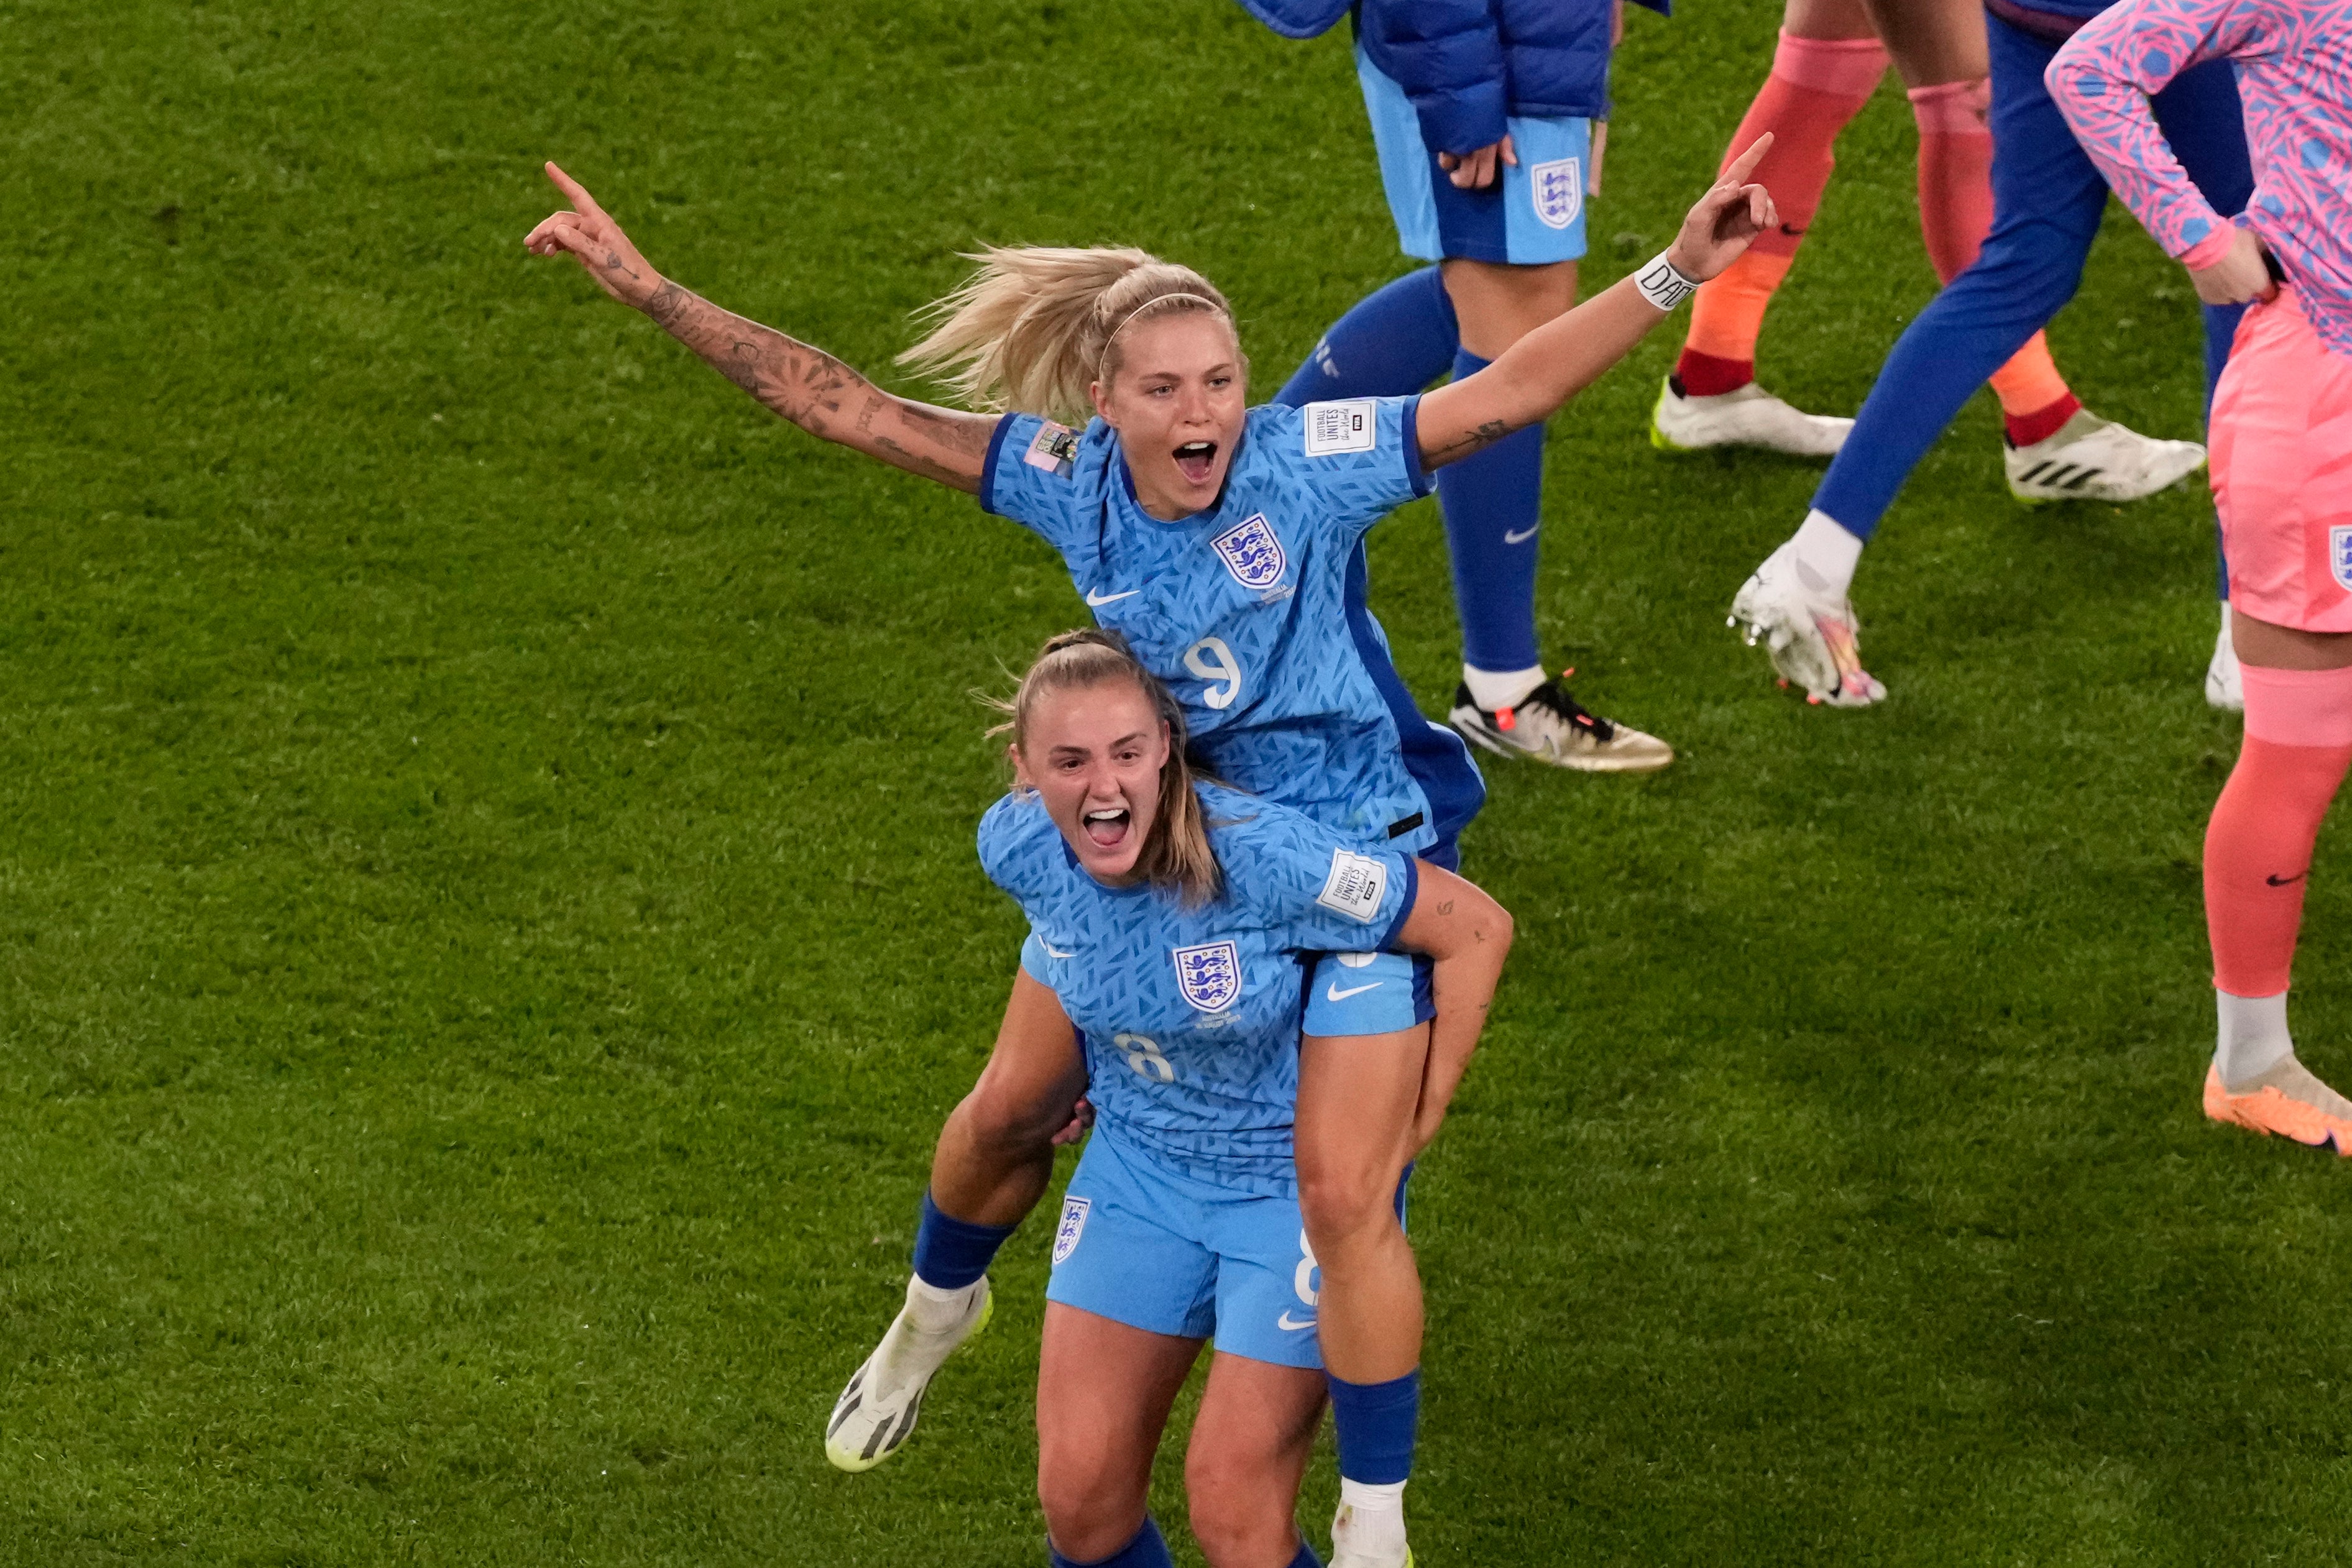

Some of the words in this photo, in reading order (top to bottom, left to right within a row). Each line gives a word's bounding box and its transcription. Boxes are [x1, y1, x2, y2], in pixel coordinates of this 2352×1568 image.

[1641, 264, 1692, 306] DAD
[1316, 410, 1326, 442] FOOTBALL
[1326, 409, 1339, 441] UNITES
[1183, 636, 1241, 709] 9
[1333, 865, 1353, 897] FOOTBALL
[1340, 869, 1360, 901] UNITES
[1350, 892, 1361, 905] the
[1356, 868, 1371, 893] World
[1113, 1033, 1175, 1083] 8
